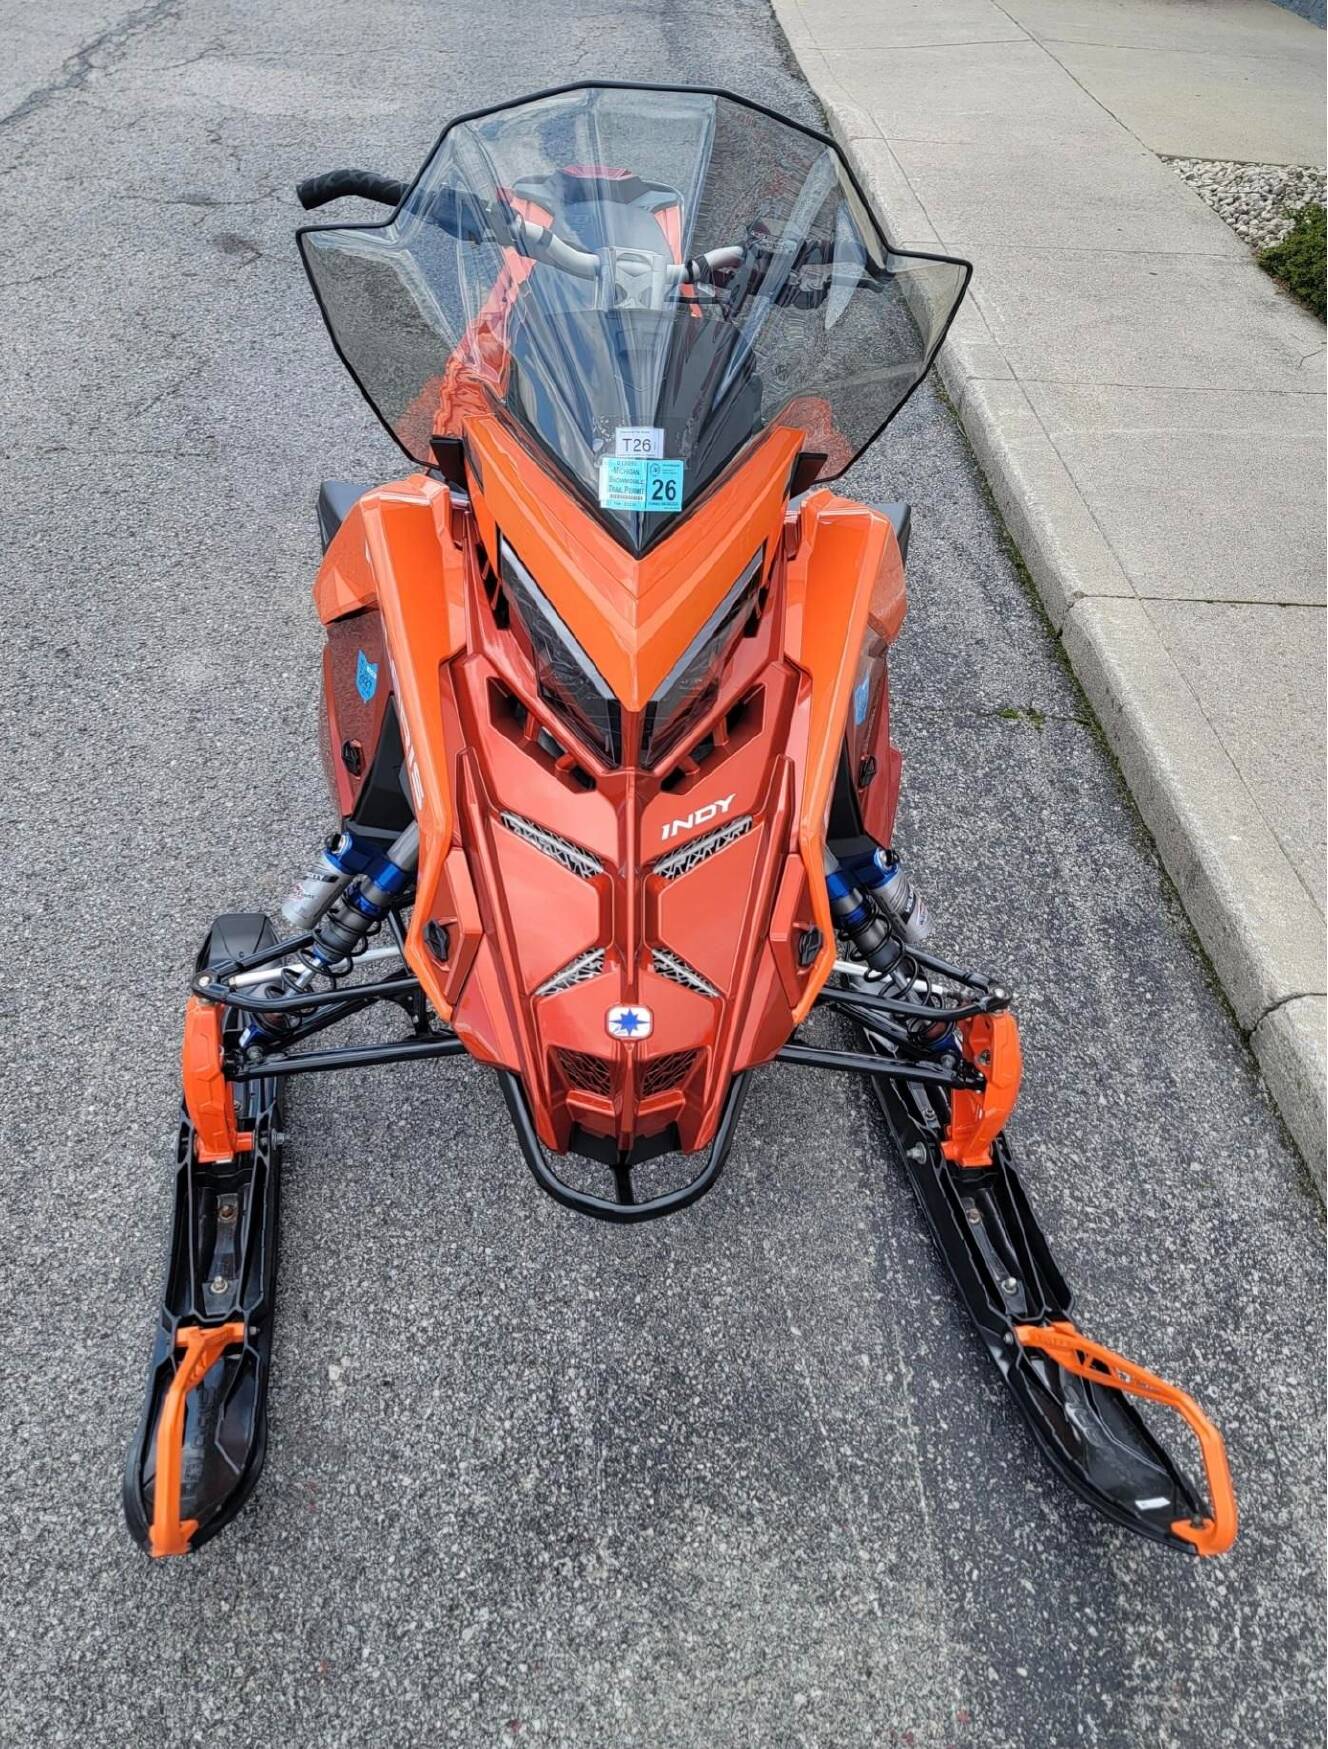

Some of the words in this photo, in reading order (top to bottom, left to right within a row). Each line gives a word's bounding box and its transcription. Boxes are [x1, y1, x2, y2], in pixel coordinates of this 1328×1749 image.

[622, 438, 652, 452] T26
[651, 479, 677, 501] 26
[661, 793, 737, 841] INDY
